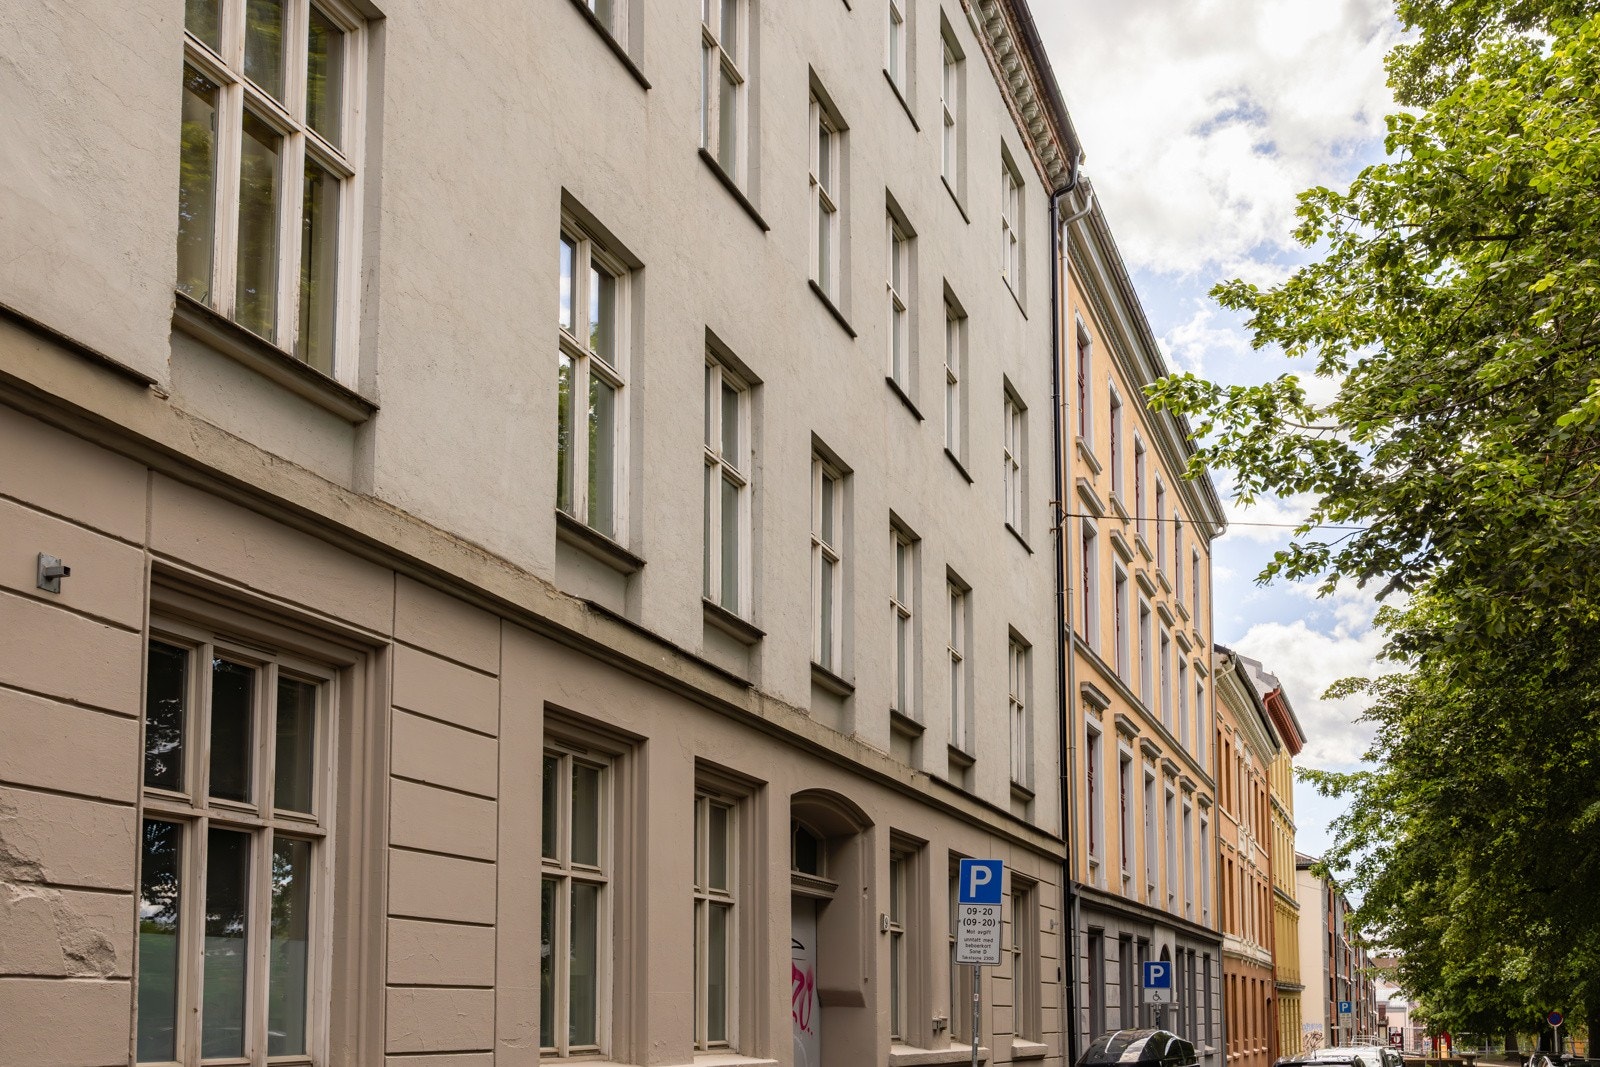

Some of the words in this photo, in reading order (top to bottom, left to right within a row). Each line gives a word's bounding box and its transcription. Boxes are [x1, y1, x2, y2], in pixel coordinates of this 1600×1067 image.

[970, 866, 992, 898] P
[966, 908, 993, 916] 09-20
[963, 918, 996, 927] (09-20)
[1150, 965, 1164, 985] P
[1342, 1002, 1348, 1012] P
